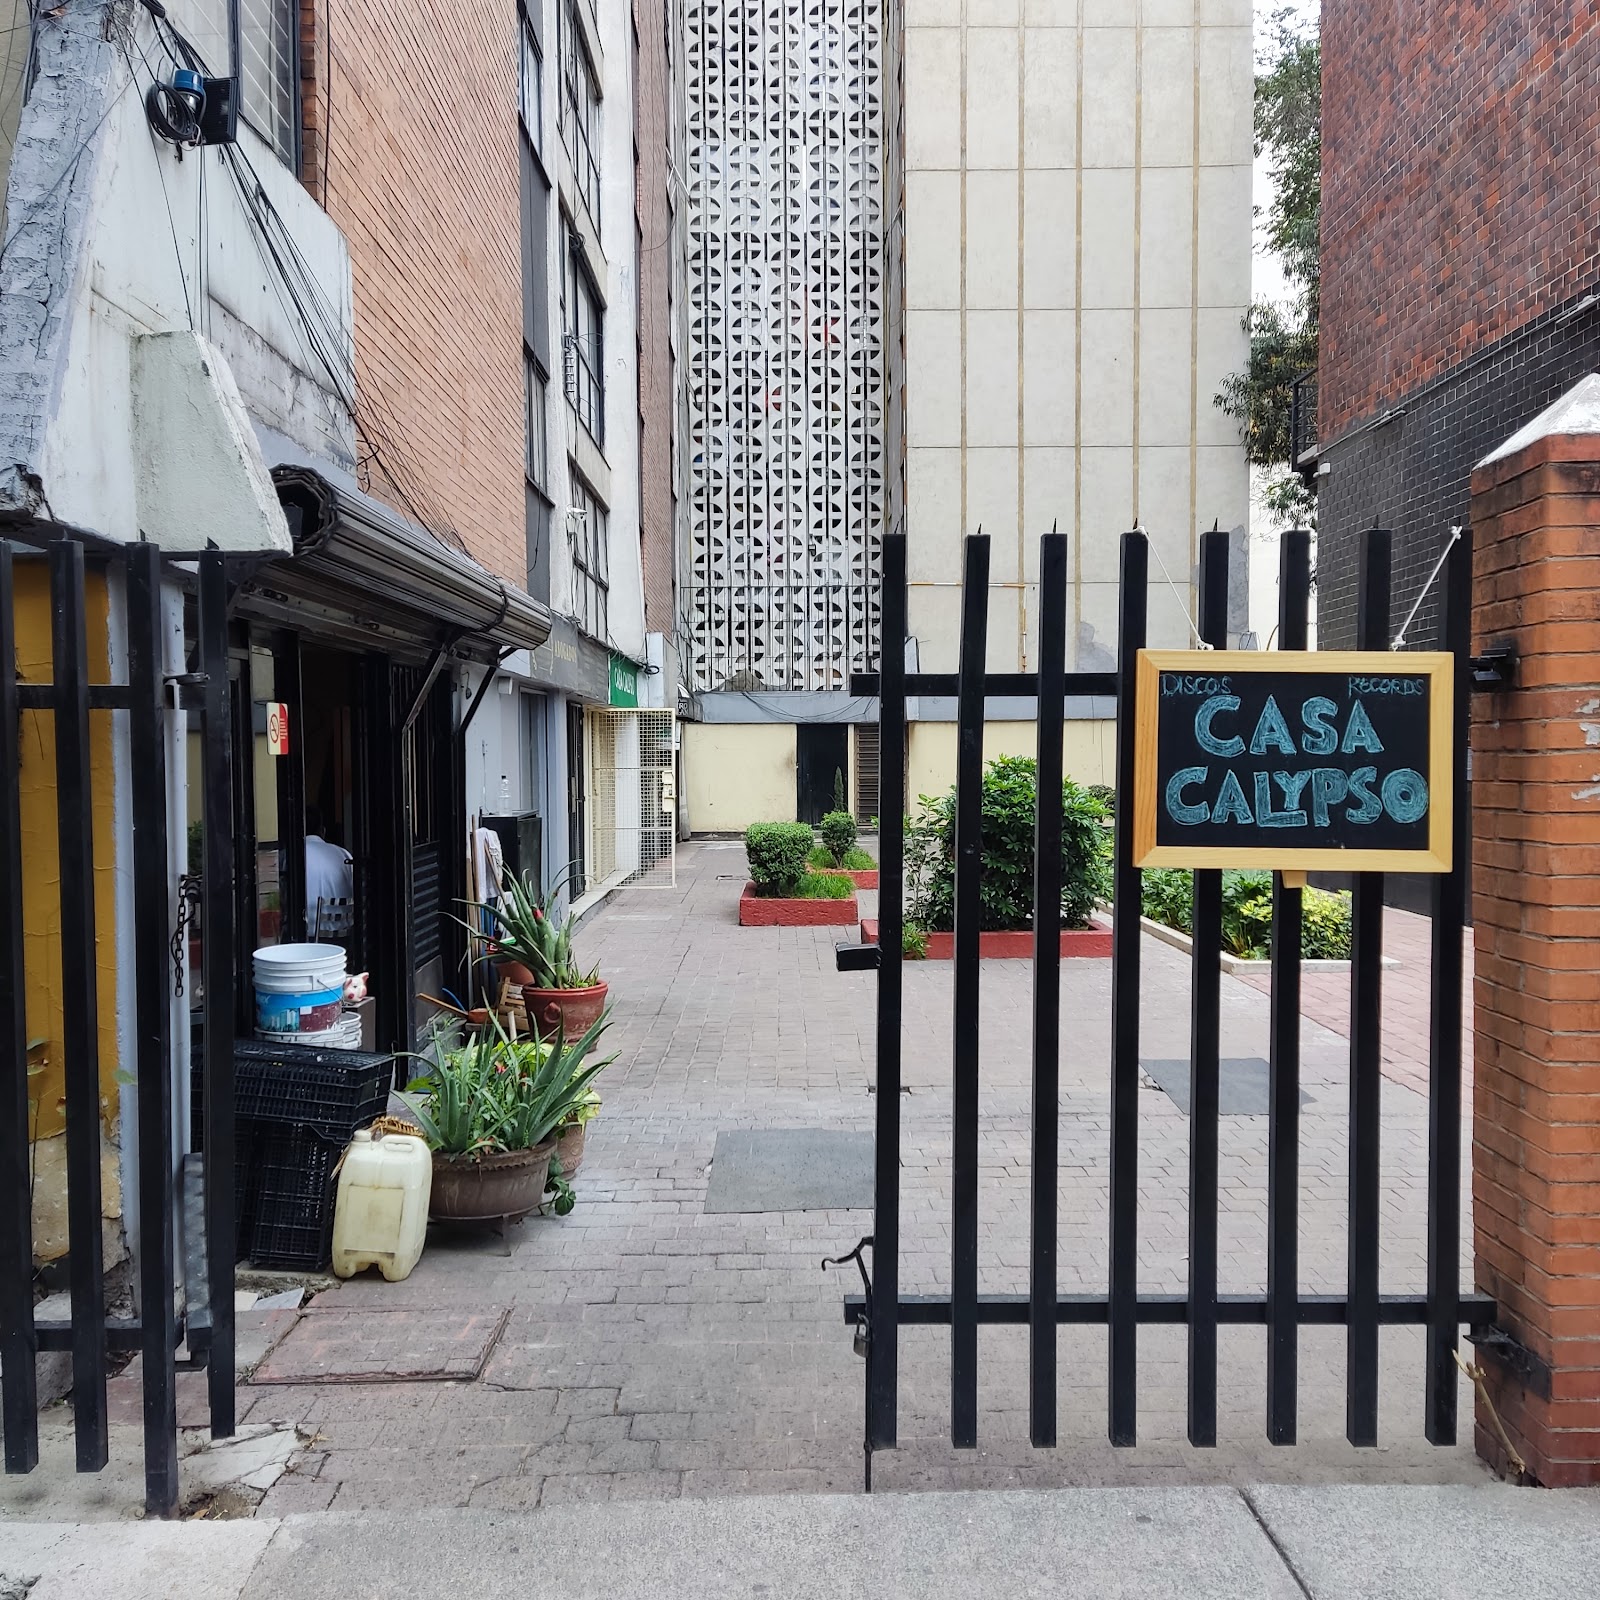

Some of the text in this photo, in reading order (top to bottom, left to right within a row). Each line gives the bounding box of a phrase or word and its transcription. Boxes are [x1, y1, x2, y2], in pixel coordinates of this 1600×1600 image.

[1160, 673, 1232, 697] DISCOS
[1348, 675, 1424, 699] RECORDS
[1194, 694, 1385, 758] CASA
[1165, 766, 1430, 828] CALYPSO
